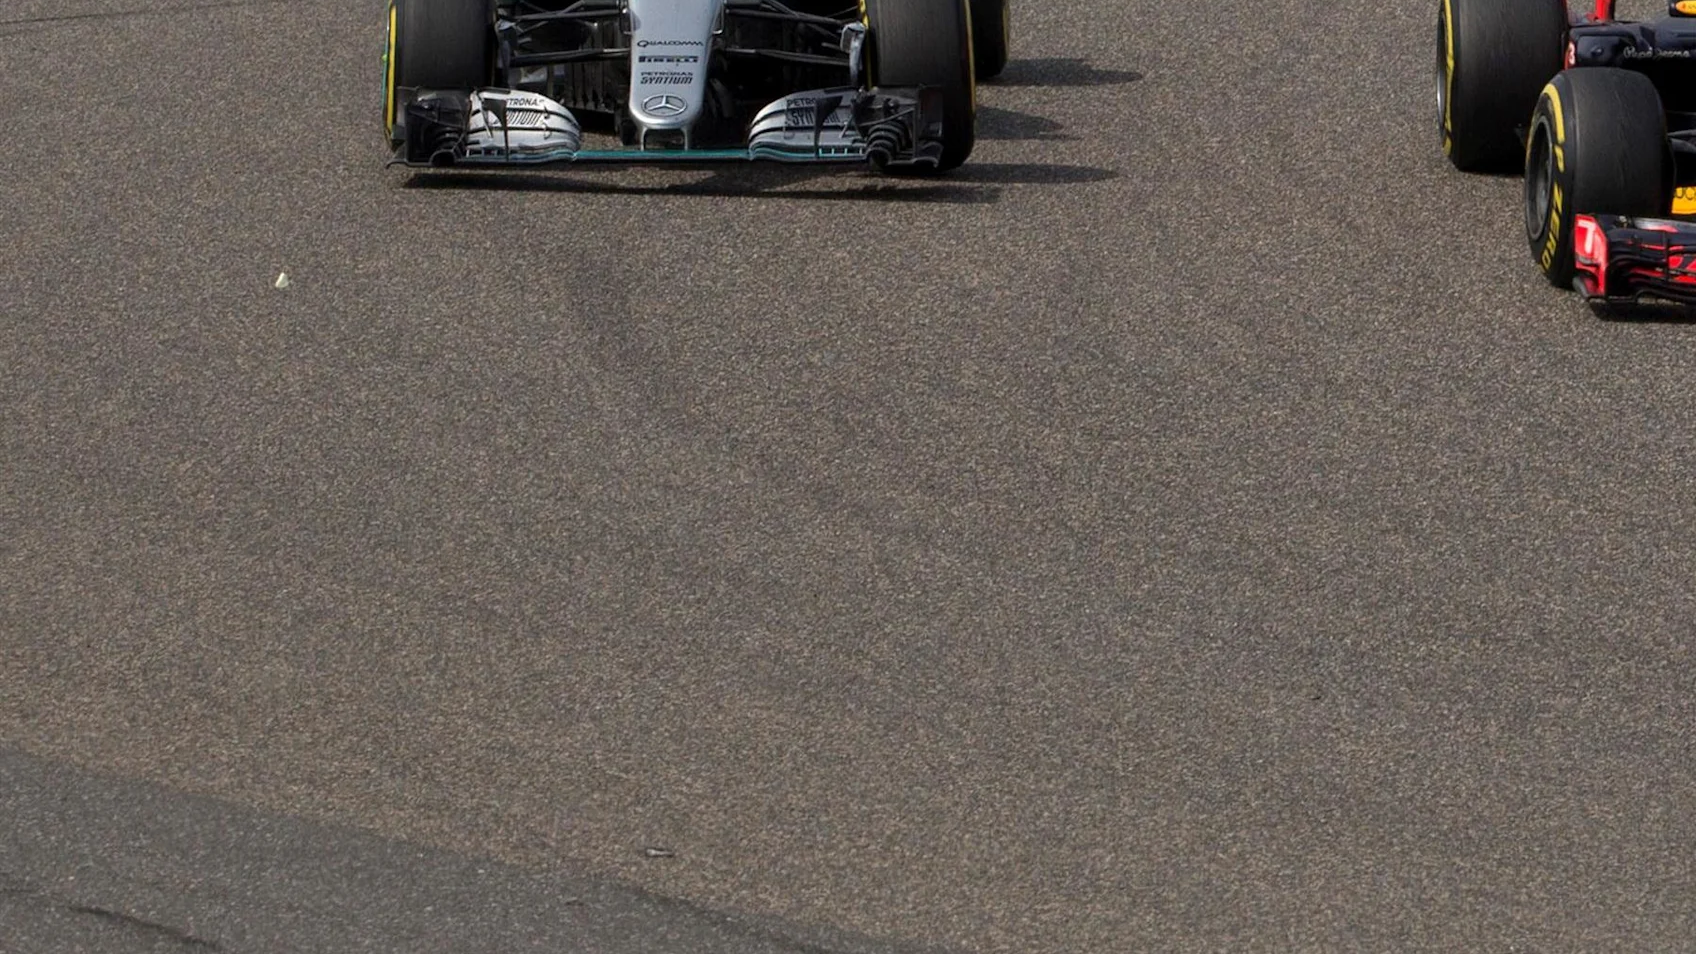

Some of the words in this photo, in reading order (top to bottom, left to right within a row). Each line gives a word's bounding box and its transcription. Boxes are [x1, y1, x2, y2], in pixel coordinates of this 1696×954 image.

[639, 76, 693, 85] SYNTIUM
[506, 98, 545, 106] TRONA
[1540, 183, 1564, 274] ZERO
